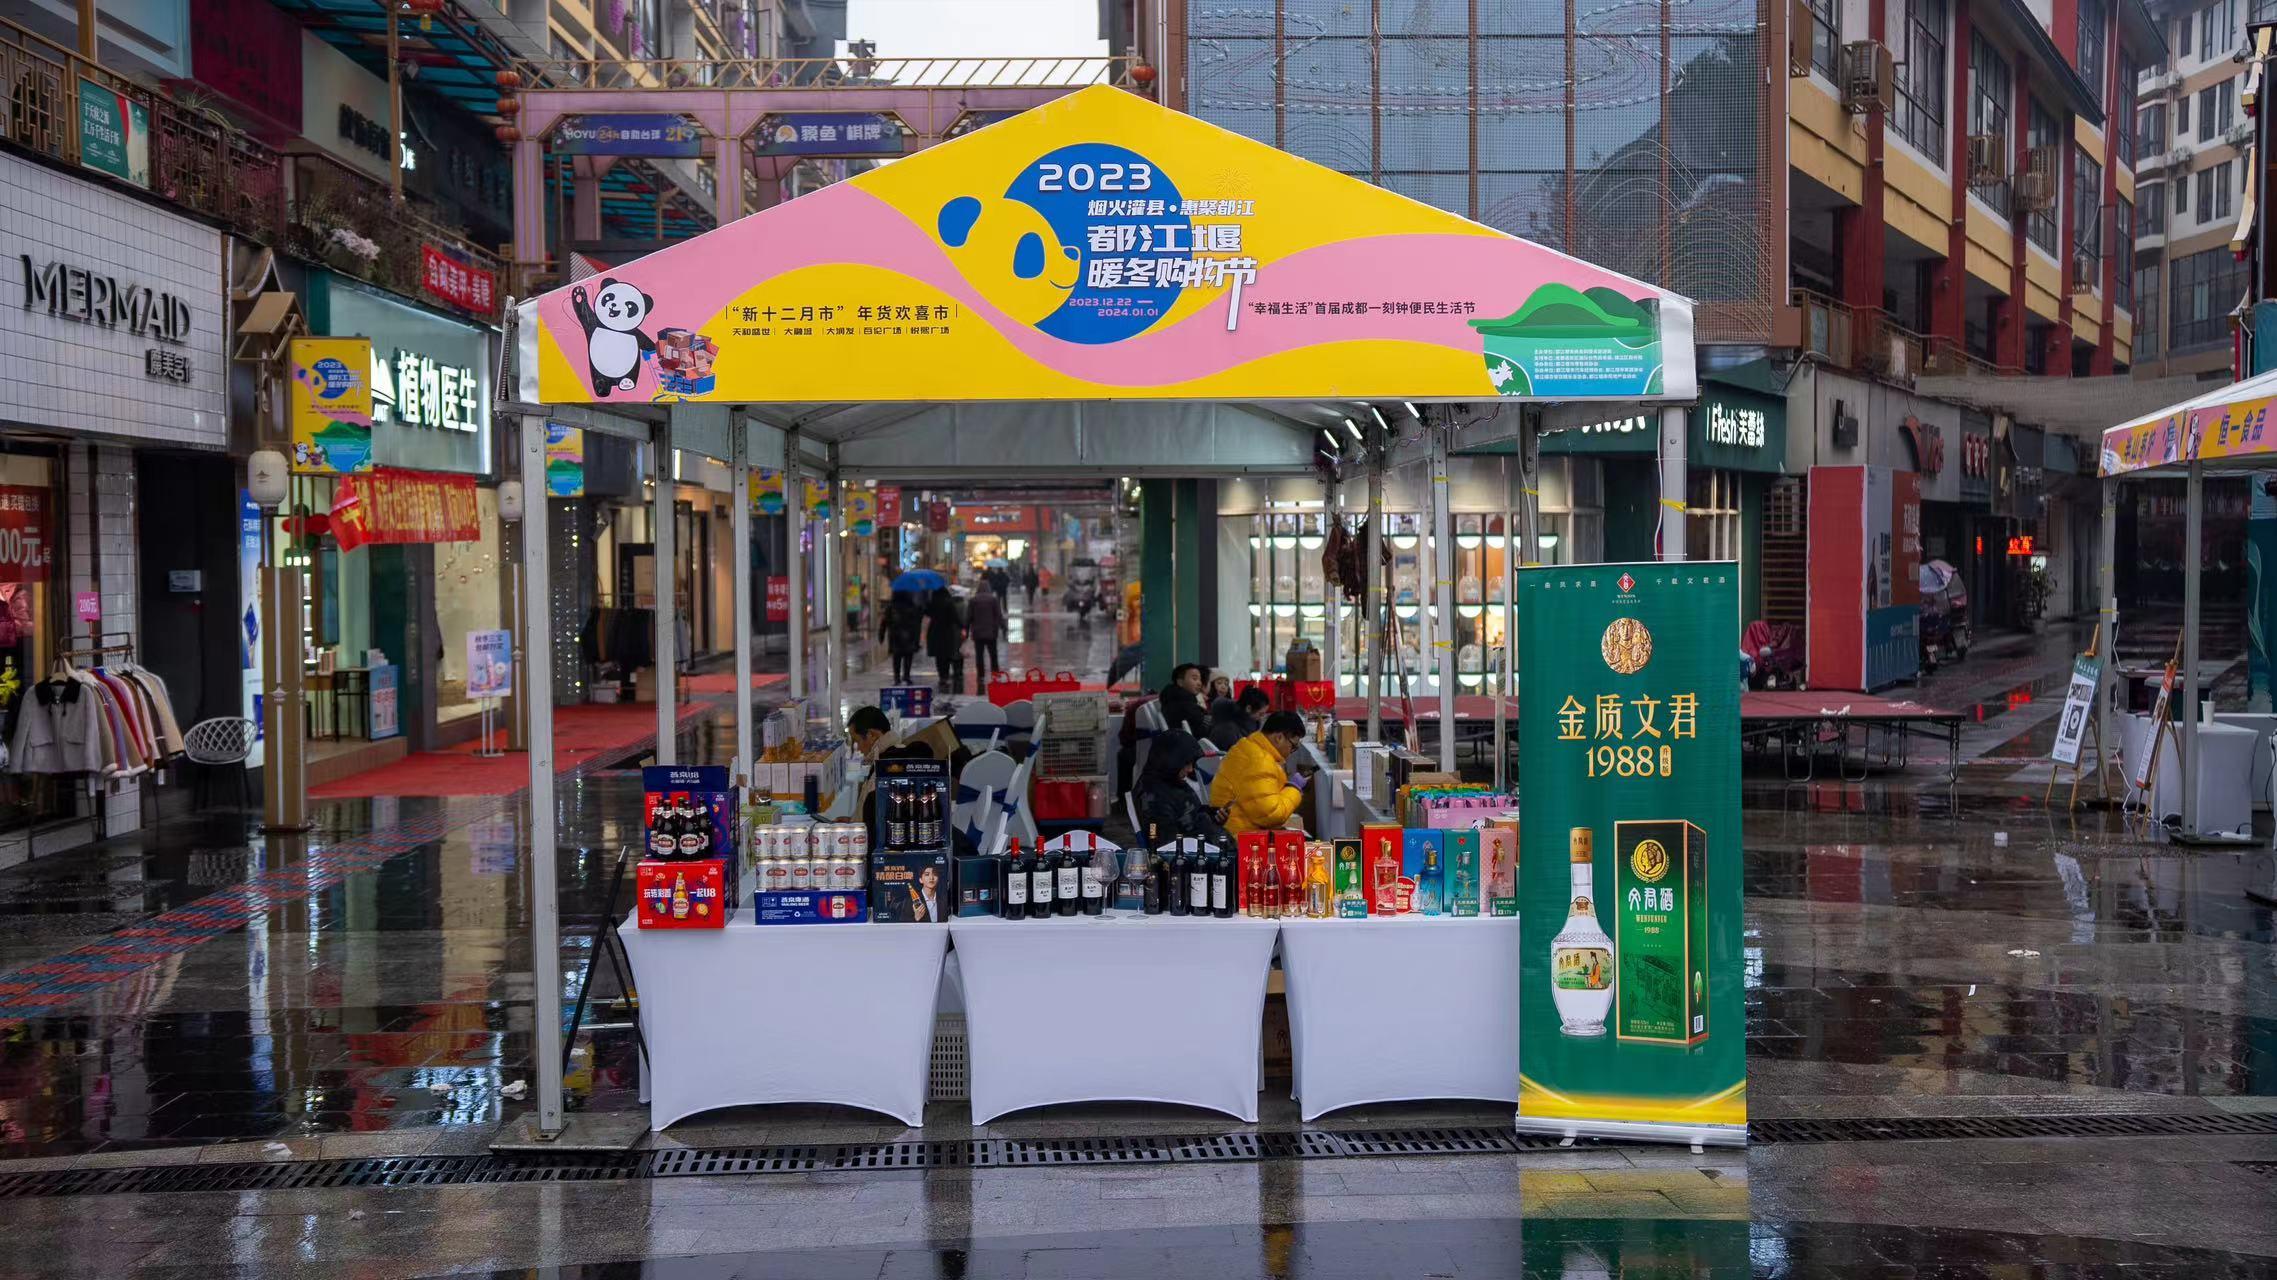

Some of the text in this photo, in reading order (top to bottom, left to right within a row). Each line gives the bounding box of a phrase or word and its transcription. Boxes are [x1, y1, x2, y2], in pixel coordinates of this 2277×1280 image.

[1038, 163, 1152, 192] 2023
[1087, 199, 1256, 216] 烟火灌县·惠聚都江
[1087, 224, 1242, 252] 都江堰
[20, 253, 192, 345] MERMAID
[1069, 297, 1132, 307] 2023.12.22
[1087, 257, 1258, 331] 暖冬购物节
[857, 305, 949, 321] 年货欢喜市
[1098, 308, 1159, 317] 2024.01.01
[826, 327, 855, 335] 大润发
[397, 349, 478, 433] 植物医生
[1557, 692, 1700, 741] 金质文君
[1586, 745, 1655, 778] 1988
[1628, 887, 1674, 912] 文君酒
